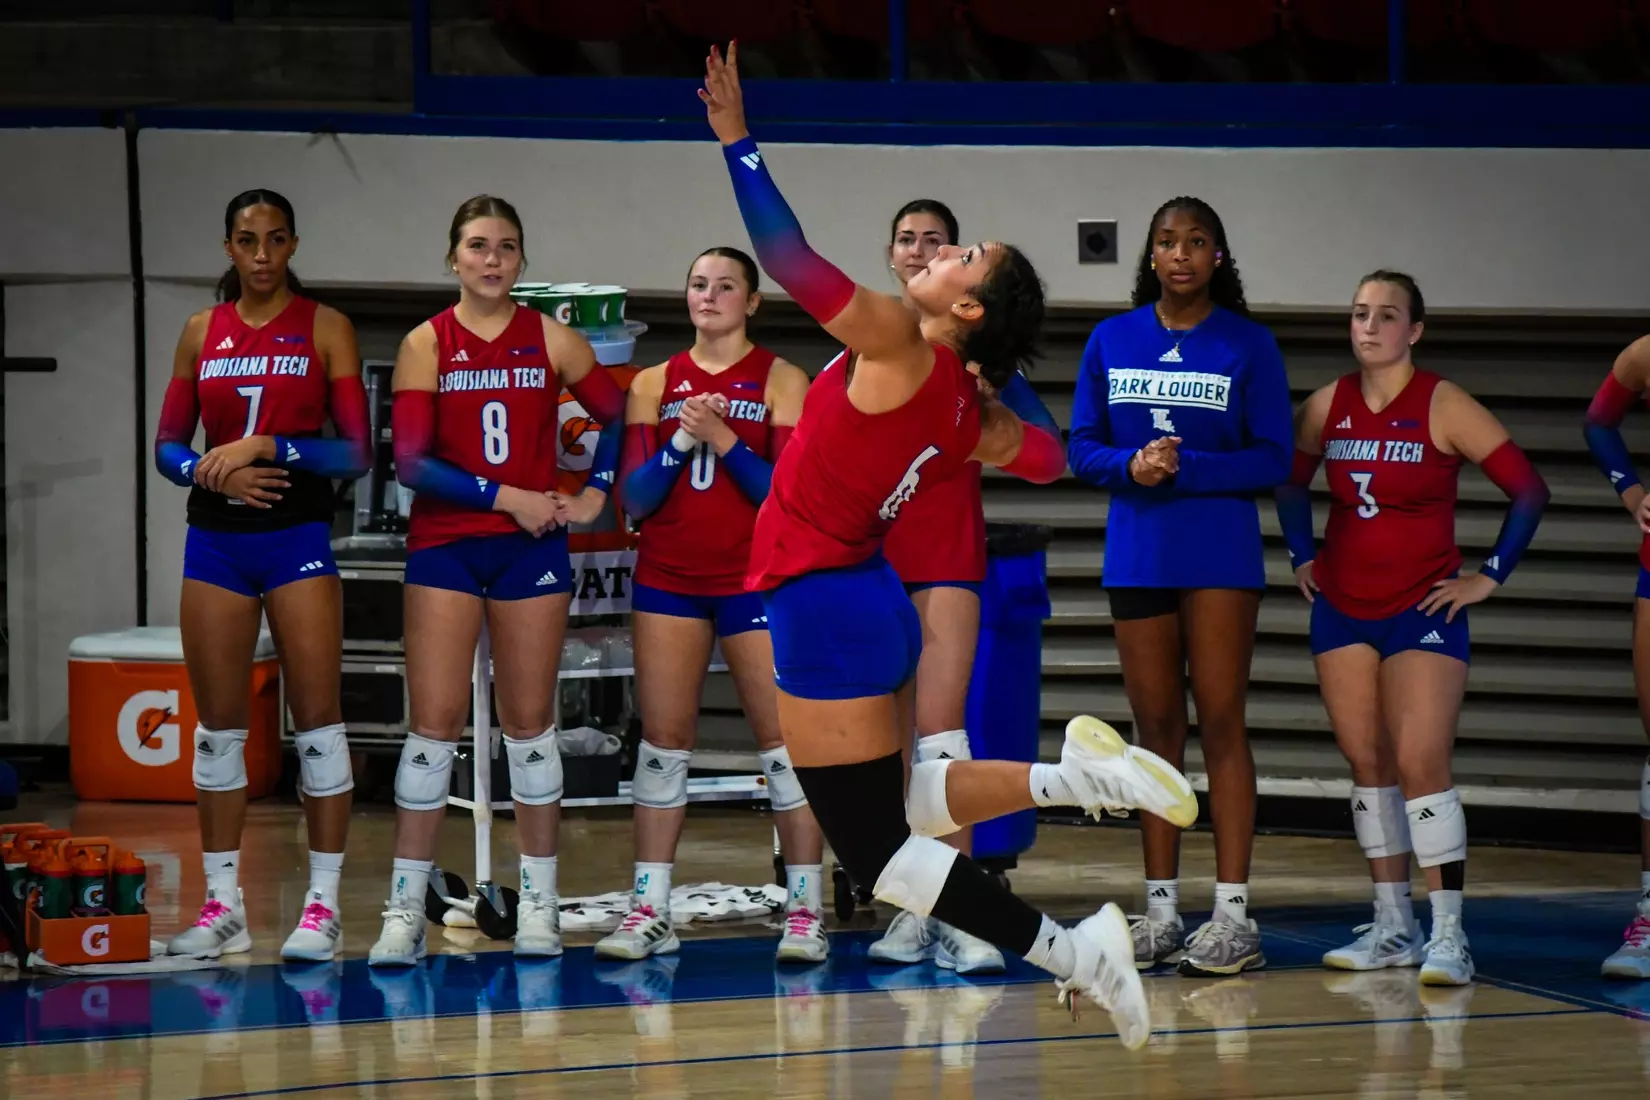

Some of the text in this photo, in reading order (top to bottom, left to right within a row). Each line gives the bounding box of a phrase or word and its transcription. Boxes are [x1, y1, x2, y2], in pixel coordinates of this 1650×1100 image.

[199, 355, 310, 381] LOUISIANA TECH
[513, 367, 546, 389] TECH
[1110, 378, 1226, 402] BARK LOUDER
[236, 386, 264, 439] 7
[729, 399, 768, 423] TECH
[482, 401, 510, 465] 8
[1383, 440, 1424, 463] TECH
[1349, 472, 1380, 519] 3
[117, 689, 180, 767] G
[83, 884, 104, 908] G
[81, 923, 110, 957] G
